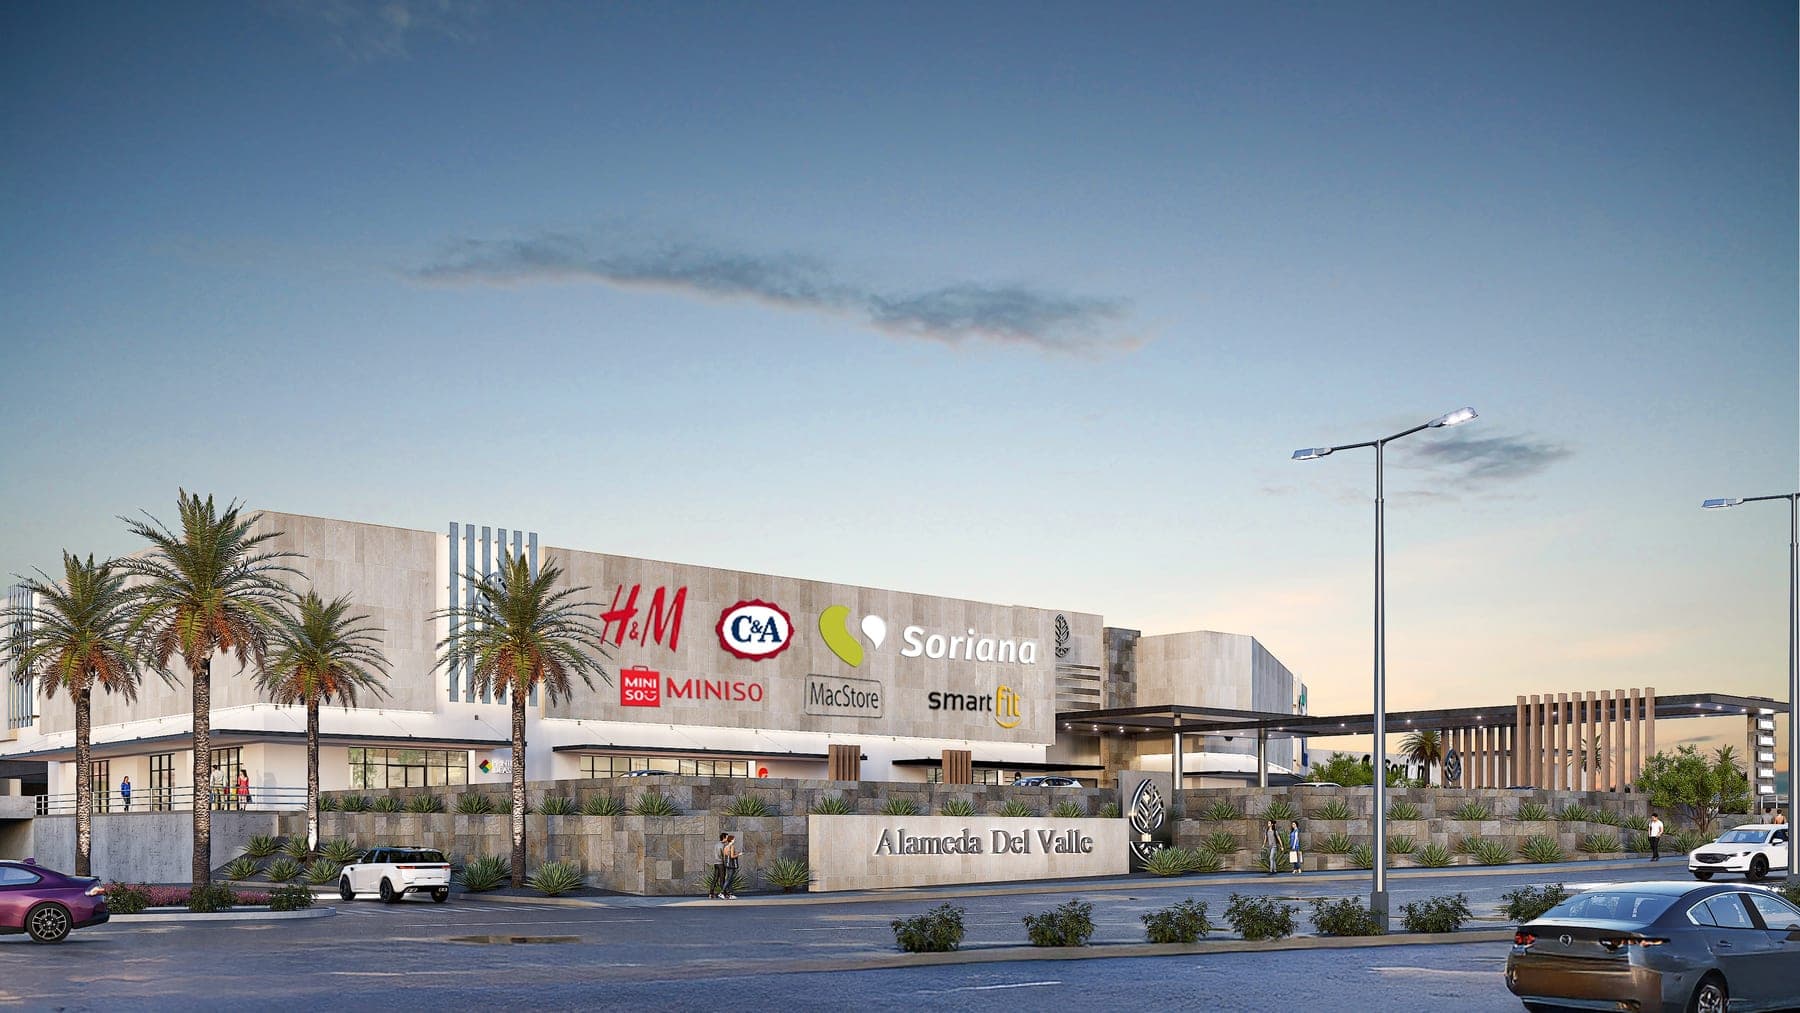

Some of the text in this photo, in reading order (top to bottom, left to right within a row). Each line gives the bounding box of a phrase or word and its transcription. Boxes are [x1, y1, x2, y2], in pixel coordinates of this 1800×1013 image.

[600, 584, 688, 653] H&M
[731, 615, 782, 643] C&A
[900, 625, 1037, 664] Soriana
[624, 677, 657, 689] MINI
[666, 677, 764, 701] MINISO
[810, 682, 879, 709] MacStore
[874, 828, 1094, 855] Alameda Del Valle
